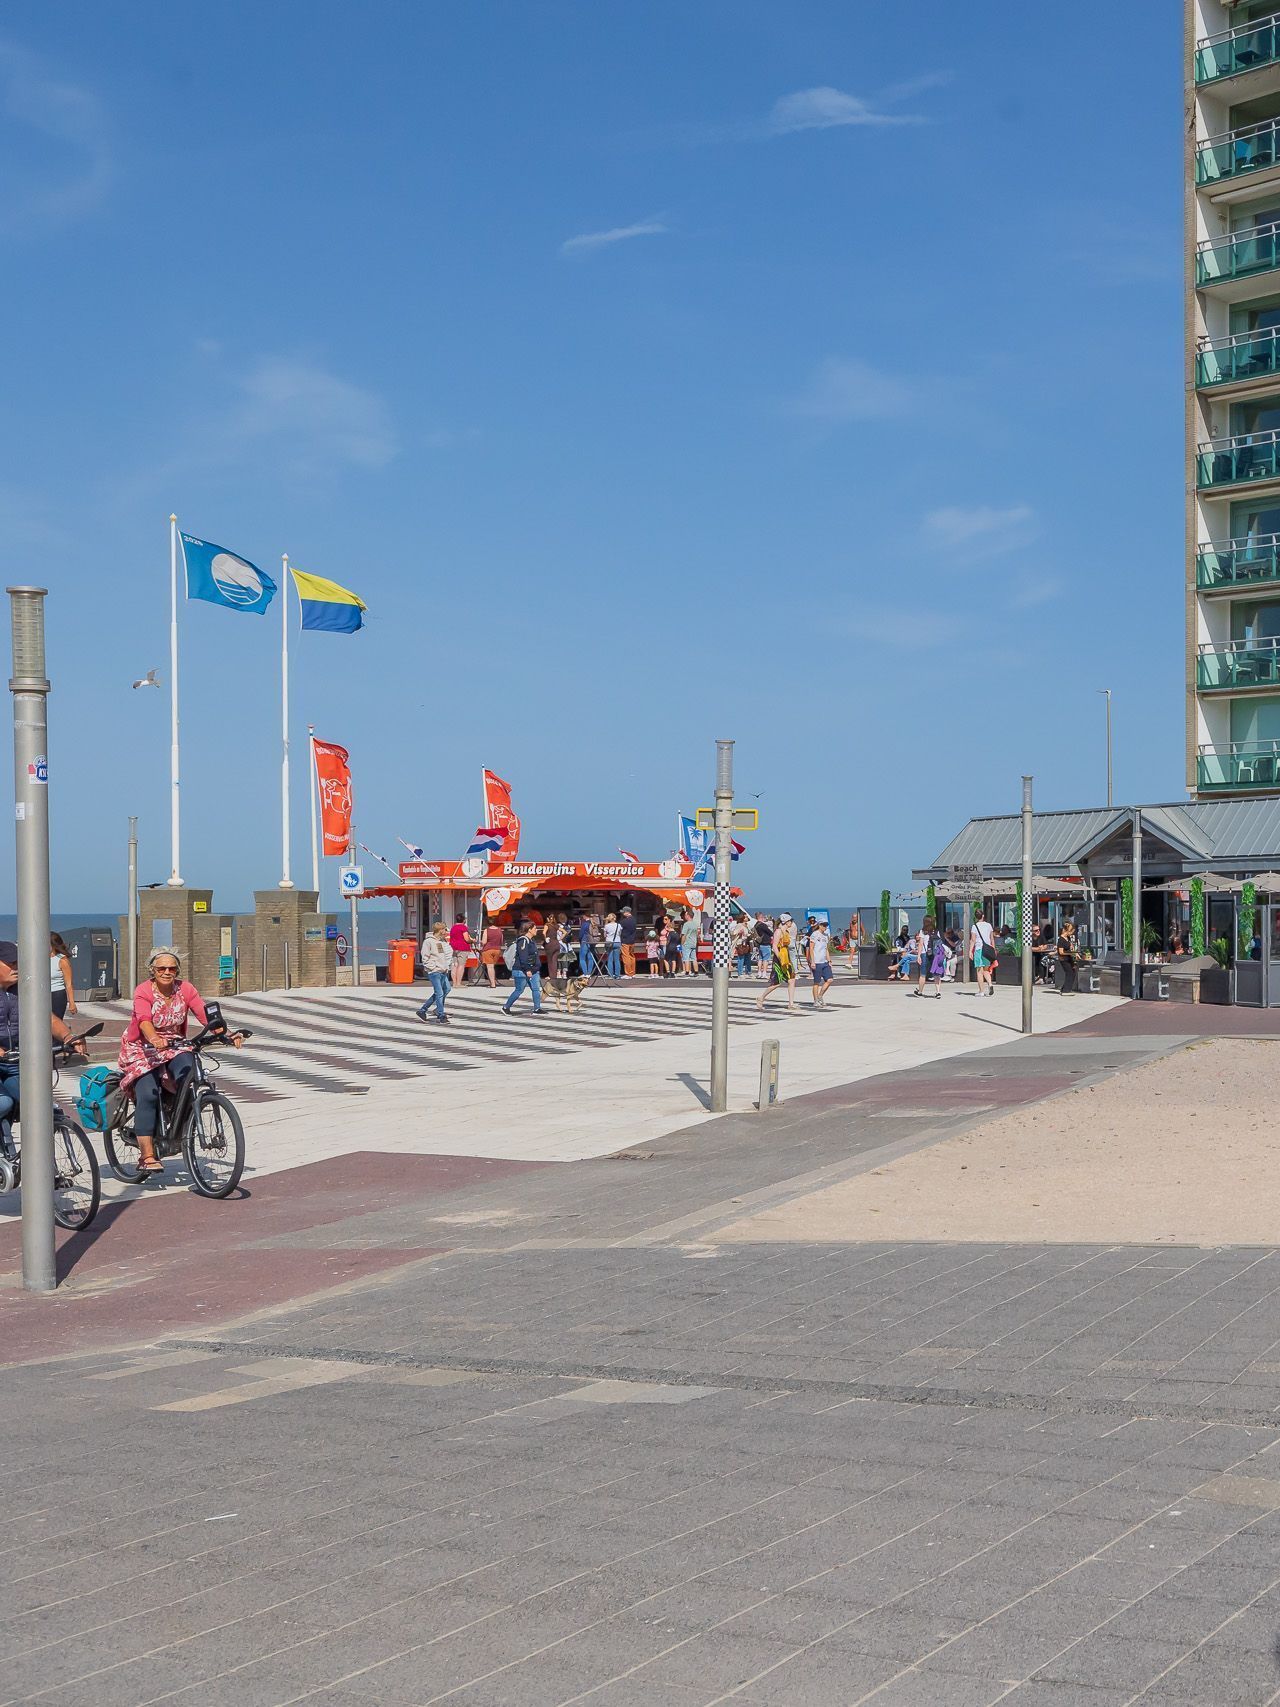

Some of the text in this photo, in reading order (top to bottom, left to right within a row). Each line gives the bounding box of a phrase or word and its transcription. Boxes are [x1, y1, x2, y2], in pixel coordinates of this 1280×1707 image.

[503, 862, 645, 876] Boudewijns Visservice
[953, 864, 979, 873] Beach
